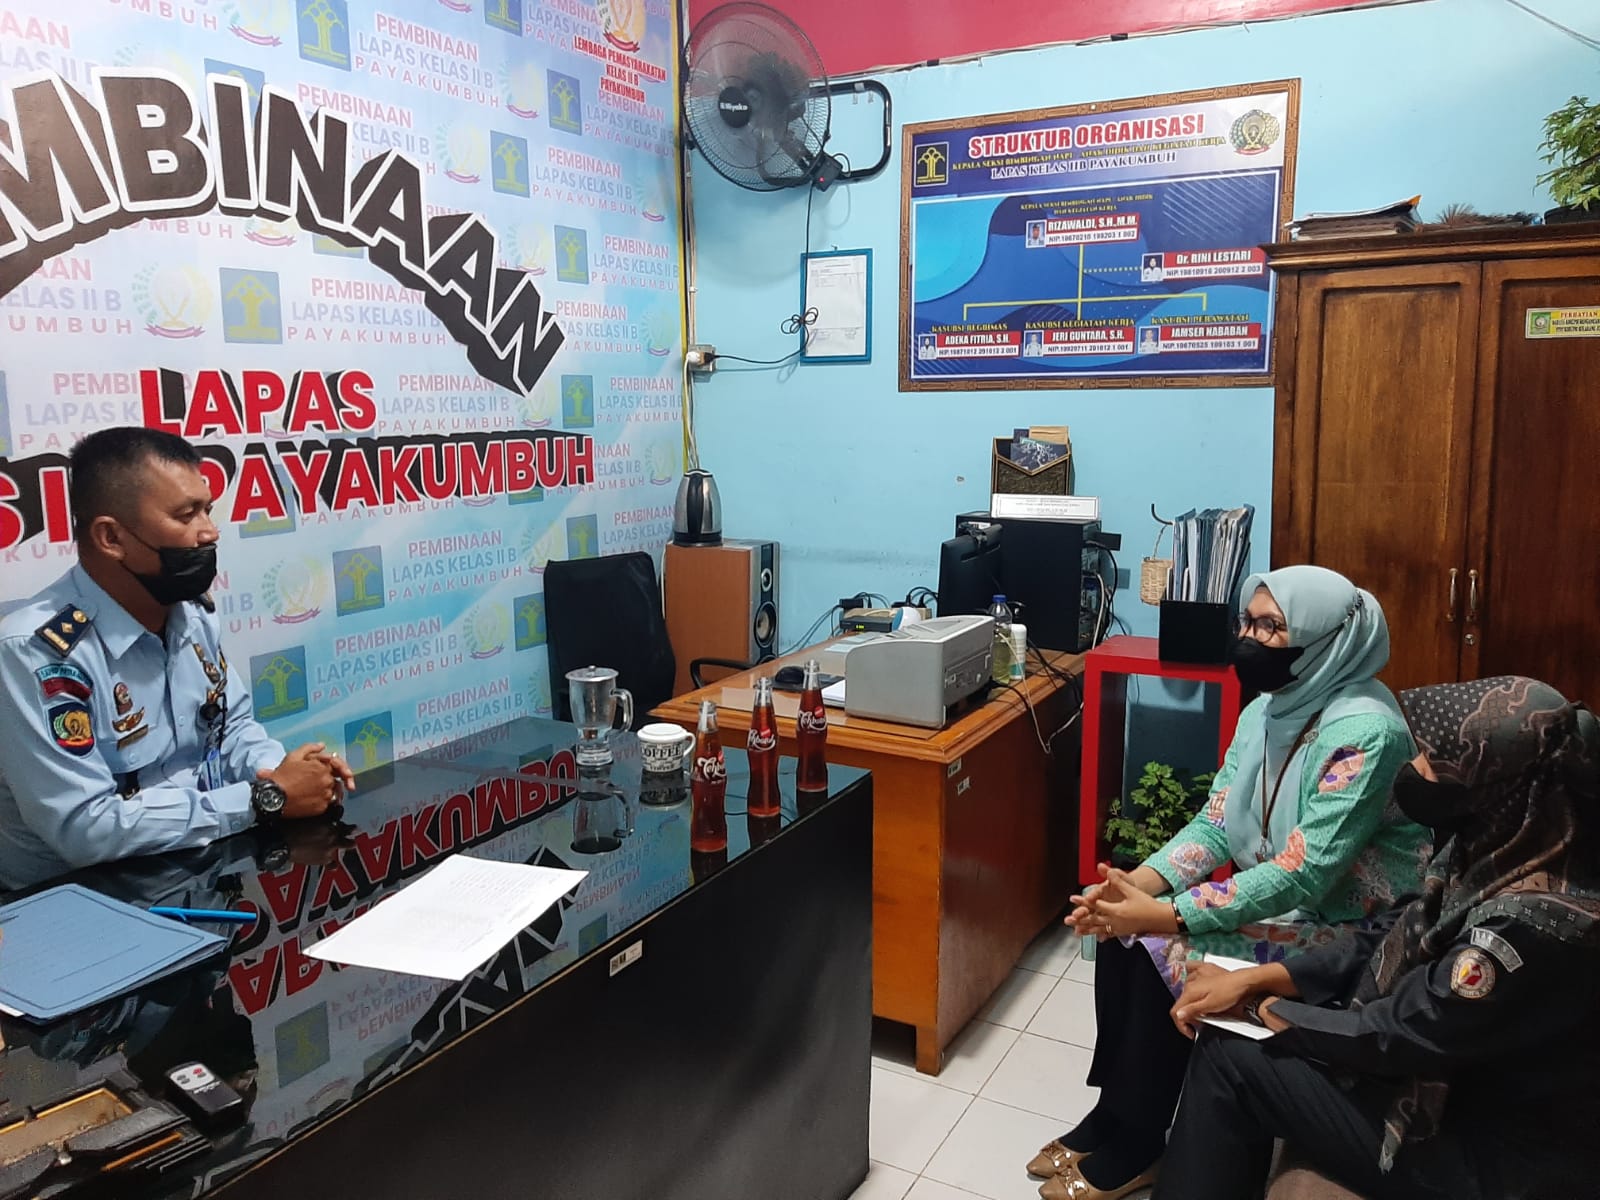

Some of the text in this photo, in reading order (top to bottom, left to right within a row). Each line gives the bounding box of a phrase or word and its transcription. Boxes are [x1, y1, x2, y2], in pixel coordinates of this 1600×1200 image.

[377, 14, 478, 62] PEMBINAAN
[359, 33, 494, 89] LAPAS KELAS II B
[573, 35, 667, 81] LEMBAGA PEMASYARAKATAN
[355, 56, 500, 109] PAYAKUMBUH
[606, 63, 626, 81] KELAS
[601, 77, 645, 103] PAYAKUMBUH
[298, 83, 412, 129] PEMBINAAN
[587, 103, 624, 128] LAPAS
[352, 120, 403, 152] KELAS
[420, 137, 430, 156] B
[970, 114, 1204, 158] STRUKTUR ORGANISASI
[548, 147, 622, 178] PEMBINAAN
[992, 166, 1027, 179] LAPAS
[1029, 162, 1066, 175] KELAS
[1090, 152, 1175, 169] PAYAKUMBUH
[535, 166, 575, 192] LAPAS
[578, 172, 614, 197] KELAS
[625, 186, 633, 200] B
[533, 184, 637, 216] PAYAKUMBUH
[605, 235, 669, 259] PEMBINAAN
[1213, 250, 1251, 262] LESTARI
[594, 253, 629, 270] LAPAS
[631, 259, 661, 276] KELAS
[104, 289, 122, 311] B
[311, 277, 424, 305] PEMBINAAN
[292, 301, 354, 325] LAPAS
[359, 306, 413, 327] KELAS
[417, 309, 427, 327] II
[556, 300, 627, 321] PEMBINAAN
[287, 326, 446, 346] PAYAKUMBUH
[585, 321, 616, 338] KELAS
[399, 374, 494, 393] PEMBINAAN
[610, 377, 674, 393] PEMBINAAN
[25, 403, 117, 427] LAPAS
[139, 368, 377, 438] LAPAS
[382, 397, 436, 415] LAPAS
[439, 397, 486, 414] KELAS
[500, 396, 510, 411] B
[600, 395, 634, 409] LAPAS
[636, 394, 668, 409] KELAS
[378, 416, 515, 433] PAYAKUMBUH
[614, 504, 675, 526] PEMBINAAN
[408, 529, 502, 559] PEMBINAAN
[603, 522, 671, 545] LAPAS KELAS
[392, 562, 444, 584] LAPAS
[448, 554, 493, 575] KELAS
[508, 549, 517, 563] B
[388, 565, 522, 602] PAYAKUMBUH
[240, 592, 254, 612] B
[335, 617, 442, 656] PEMBINAAN
[316, 659, 377, 686] LAPAS
[380, 640, 432, 668] KELAS
[447, 634, 458, 651] B
[312, 652, 464, 703] PAYAKUMBUH
[417, 677, 510, 718] PEMBINAAN
[402, 715, 452, 745] LAPAS
[456, 699, 500, 726] KELAS
[515, 692, 523, 707] B
